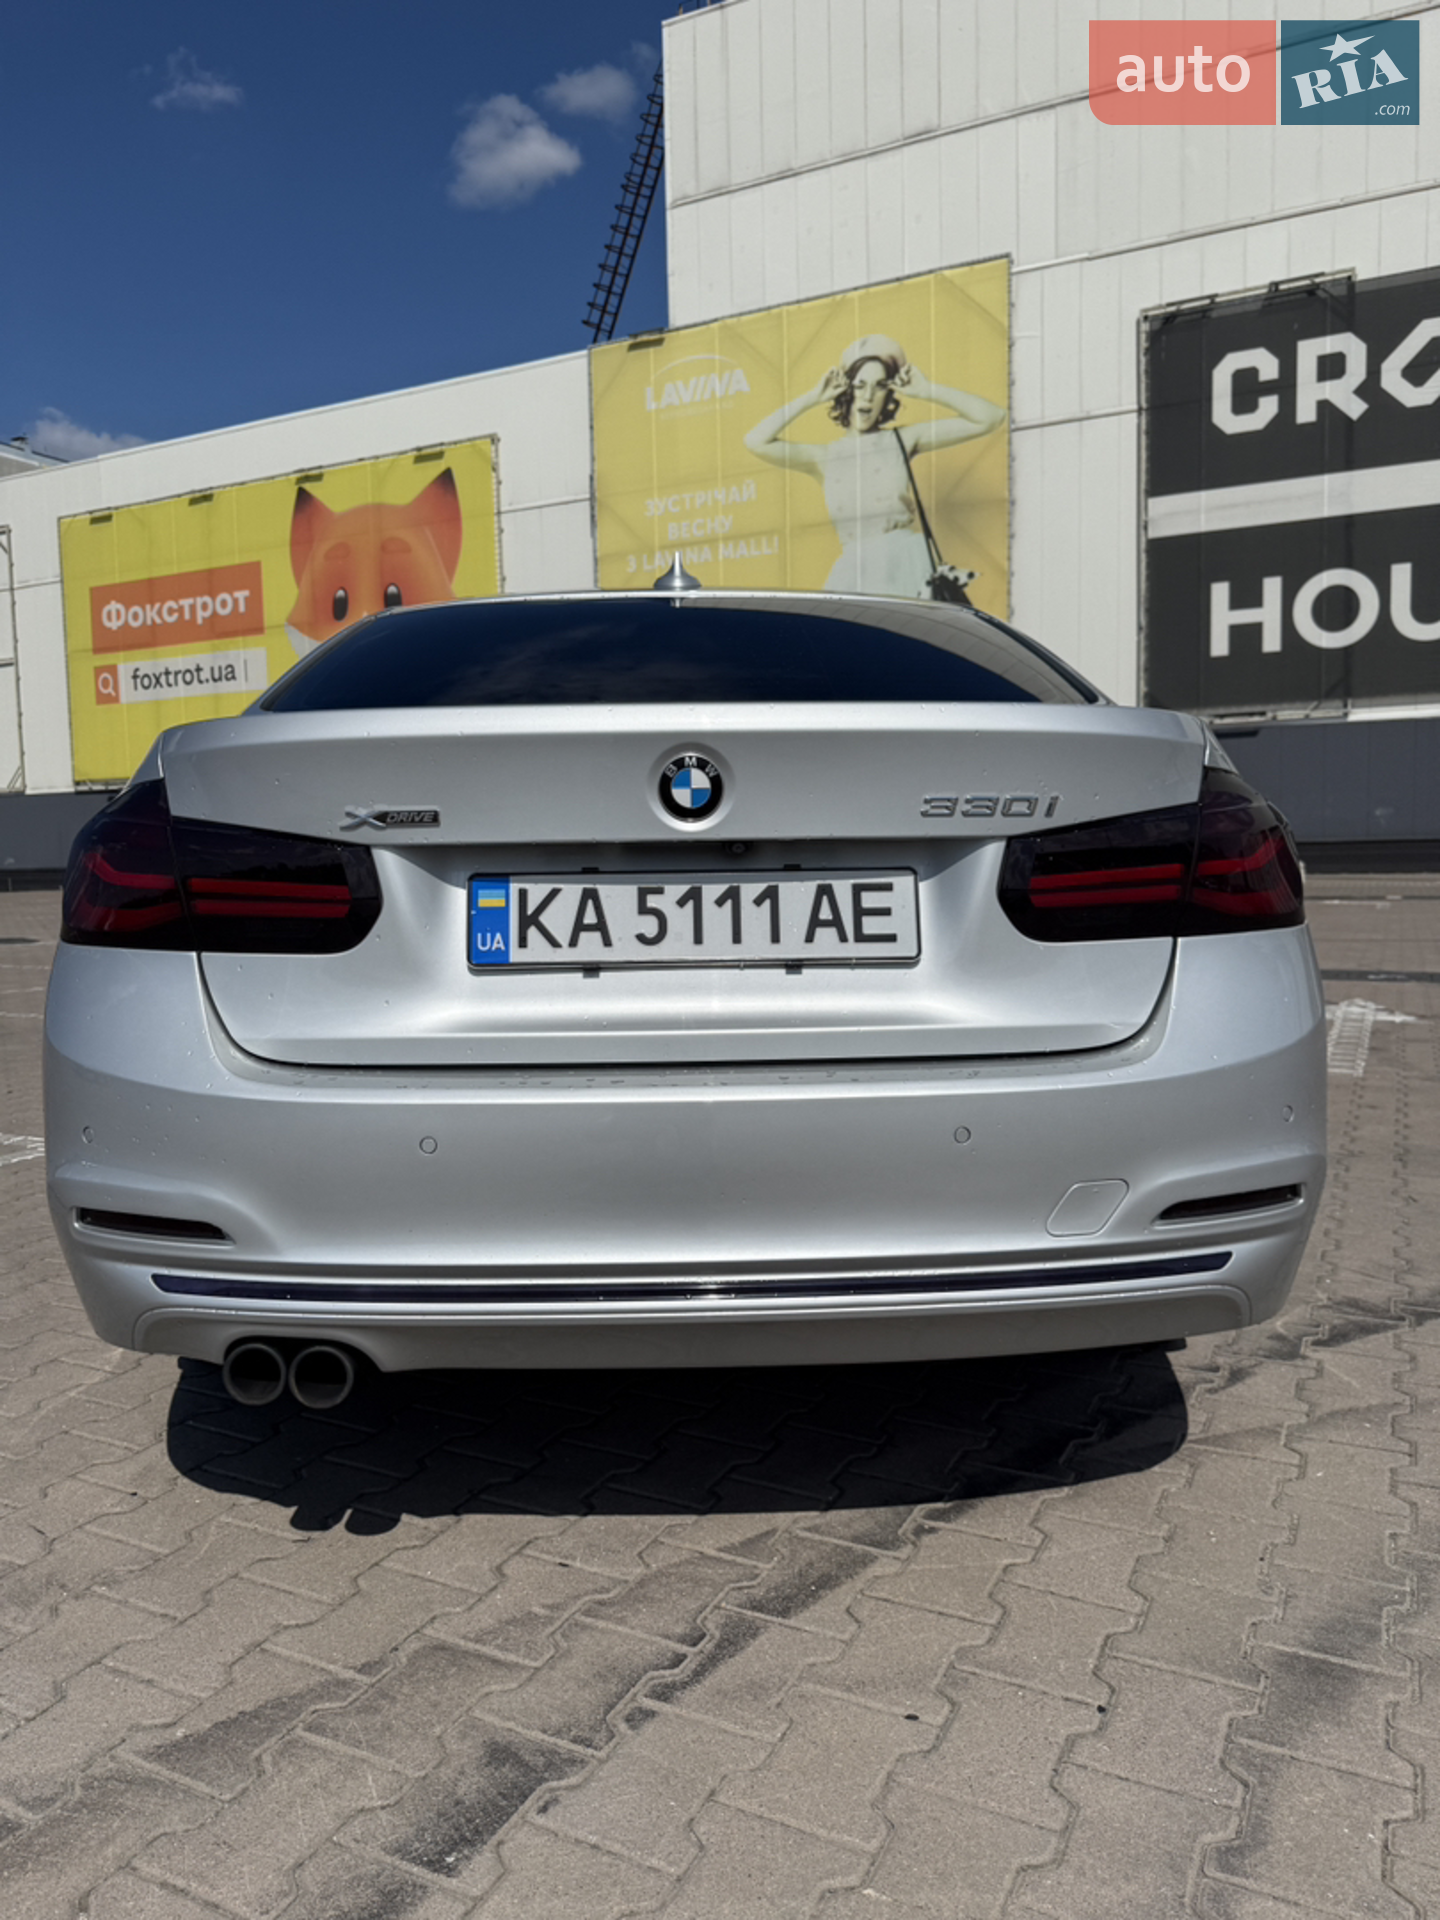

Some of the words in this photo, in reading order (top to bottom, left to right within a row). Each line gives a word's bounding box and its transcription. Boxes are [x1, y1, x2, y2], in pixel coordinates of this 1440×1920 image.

[645, 369, 751, 412] LAVINA
[644, 479, 757, 517] ЗУСТРІЧАЙ
[667, 514, 734, 541] ВЕСНУ
[101, 589, 250, 630] Фокстрот
[1209, 562, 1440, 658] HOU
[131, 663, 237, 691] foxtrot.ua
[664, 756, 719, 777] BMW
[635, 884, 781, 946] 5111
[477, 932, 506, 951] UA
